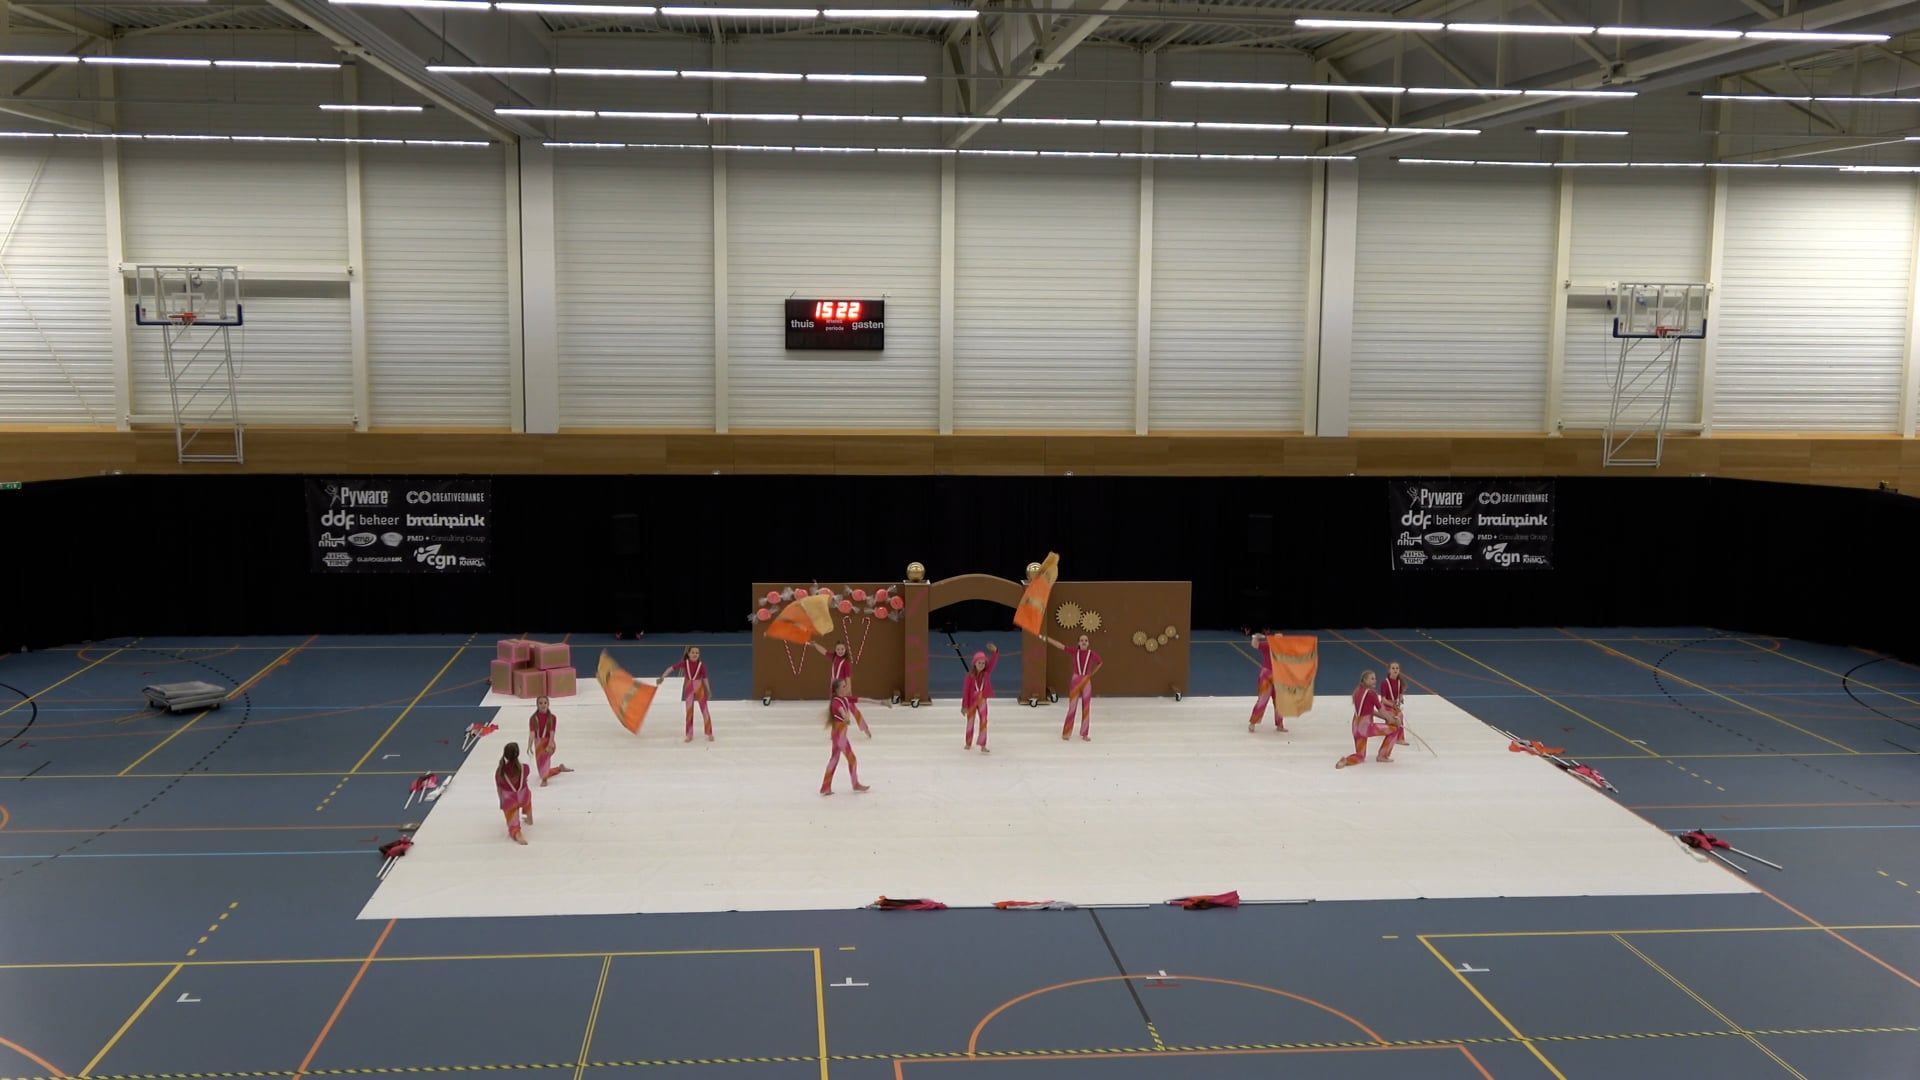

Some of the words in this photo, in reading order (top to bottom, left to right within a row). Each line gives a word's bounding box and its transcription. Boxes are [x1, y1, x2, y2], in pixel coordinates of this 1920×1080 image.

[790, 320, 815, 328] thuis
[852, 321, 884, 330] gasten
[341, 487, 388, 507] Pyware
[432, 492, 485, 503] CREATIVEORANGE
[1421, 488, 1463, 508] Pyware
[321, 510, 355, 530] ddf
[360, 514, 400, 526] beheer
[406, 514, 486, 528] brainpink
[1401, 510, 1432, 530] ddf
[1436, 514, 1472, 526] beheer
[1478, 514, 1548, 528] brainpink
[466, 536, 486, 544] Group
[427, 554, 456, 570] cgn
[1494, 552, 1520, 567] cgn
